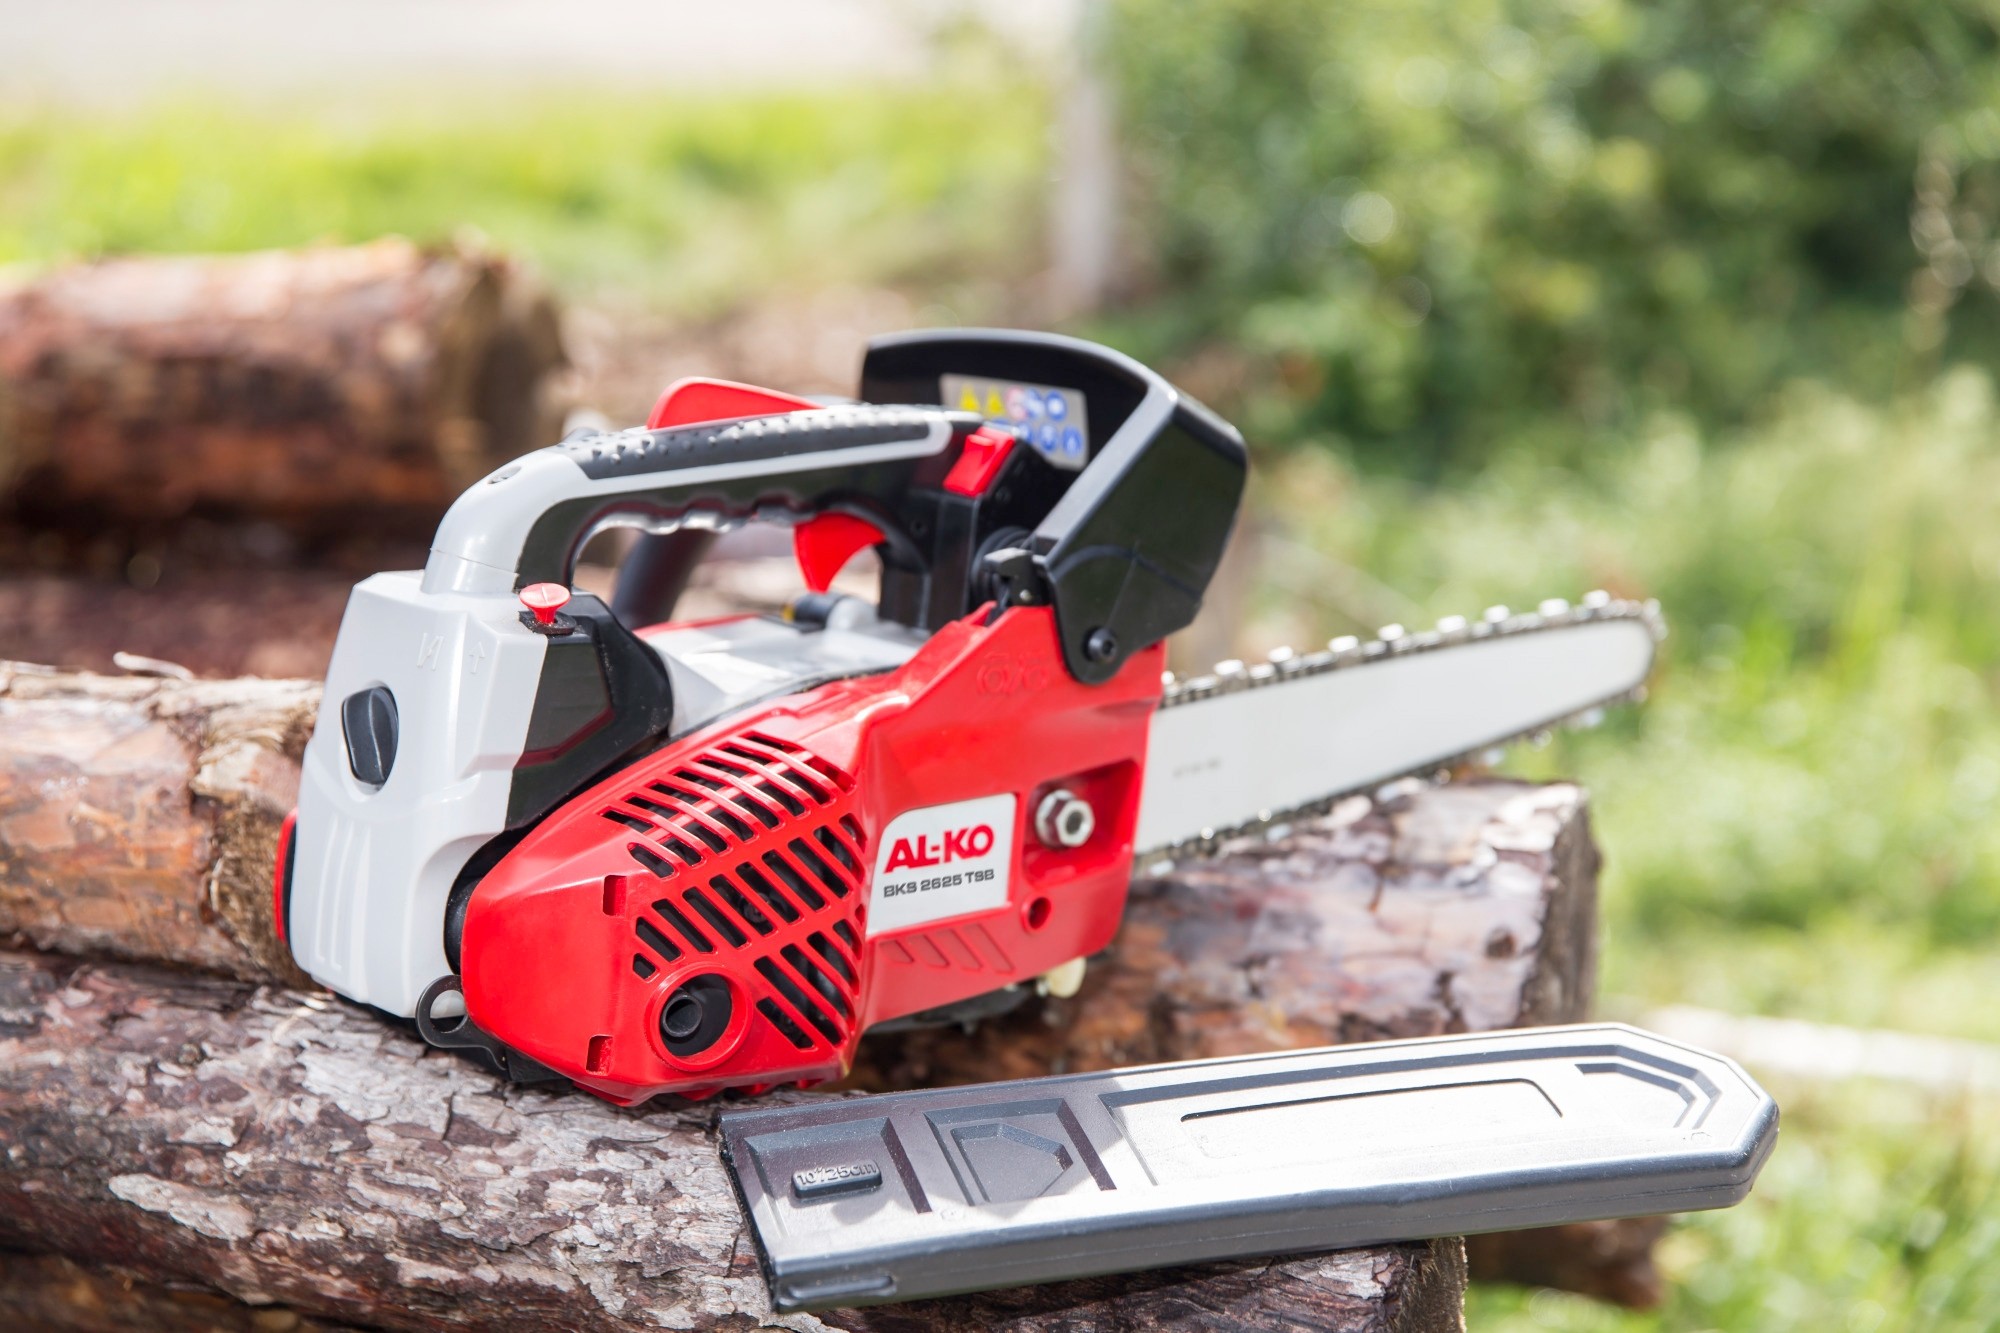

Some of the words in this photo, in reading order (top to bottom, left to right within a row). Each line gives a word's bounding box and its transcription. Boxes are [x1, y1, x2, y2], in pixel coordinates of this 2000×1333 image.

[884, 824, 994, 874] AL-KO
[884, 881, 917, 898] BKS
[920, 874, 962, 891] 2625
[965, 869, 995, 884] TSB
